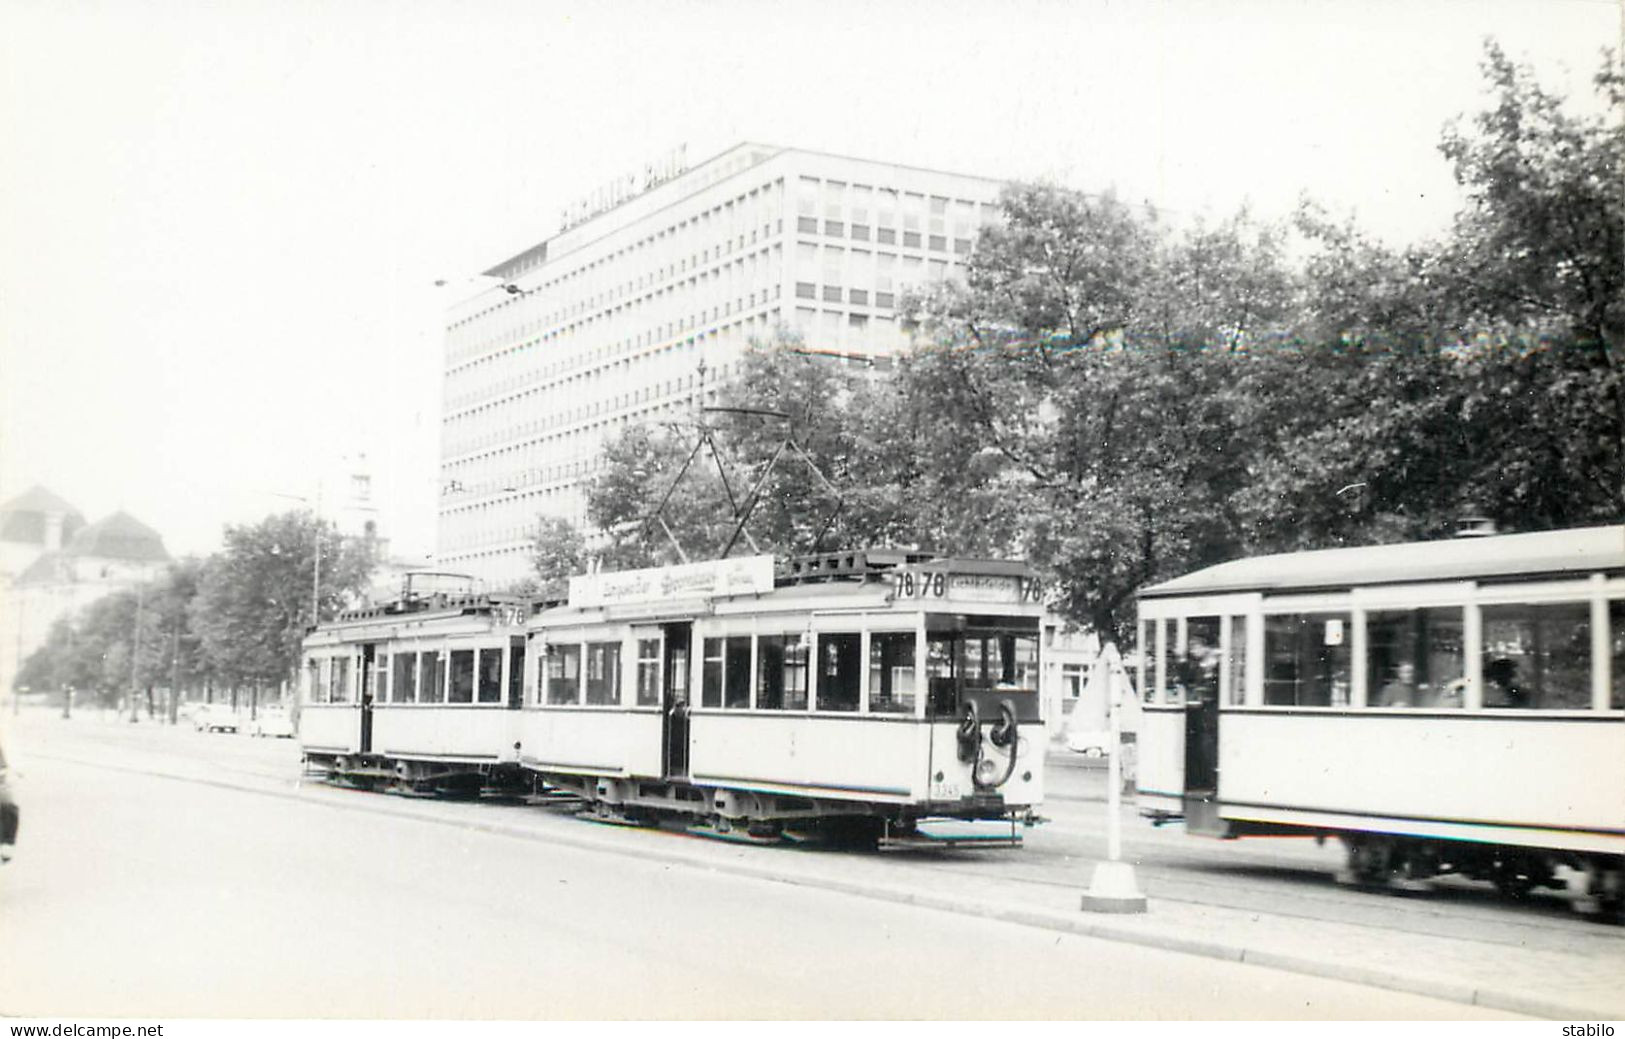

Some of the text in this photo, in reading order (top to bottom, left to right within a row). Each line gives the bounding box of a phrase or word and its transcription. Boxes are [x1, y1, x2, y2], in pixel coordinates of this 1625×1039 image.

[895, 572, 914, 597] 78
[921, 572, 945, 597] 78
[1022, 577, 1041, 602] 78
[507, 608, 525, 625] 78
